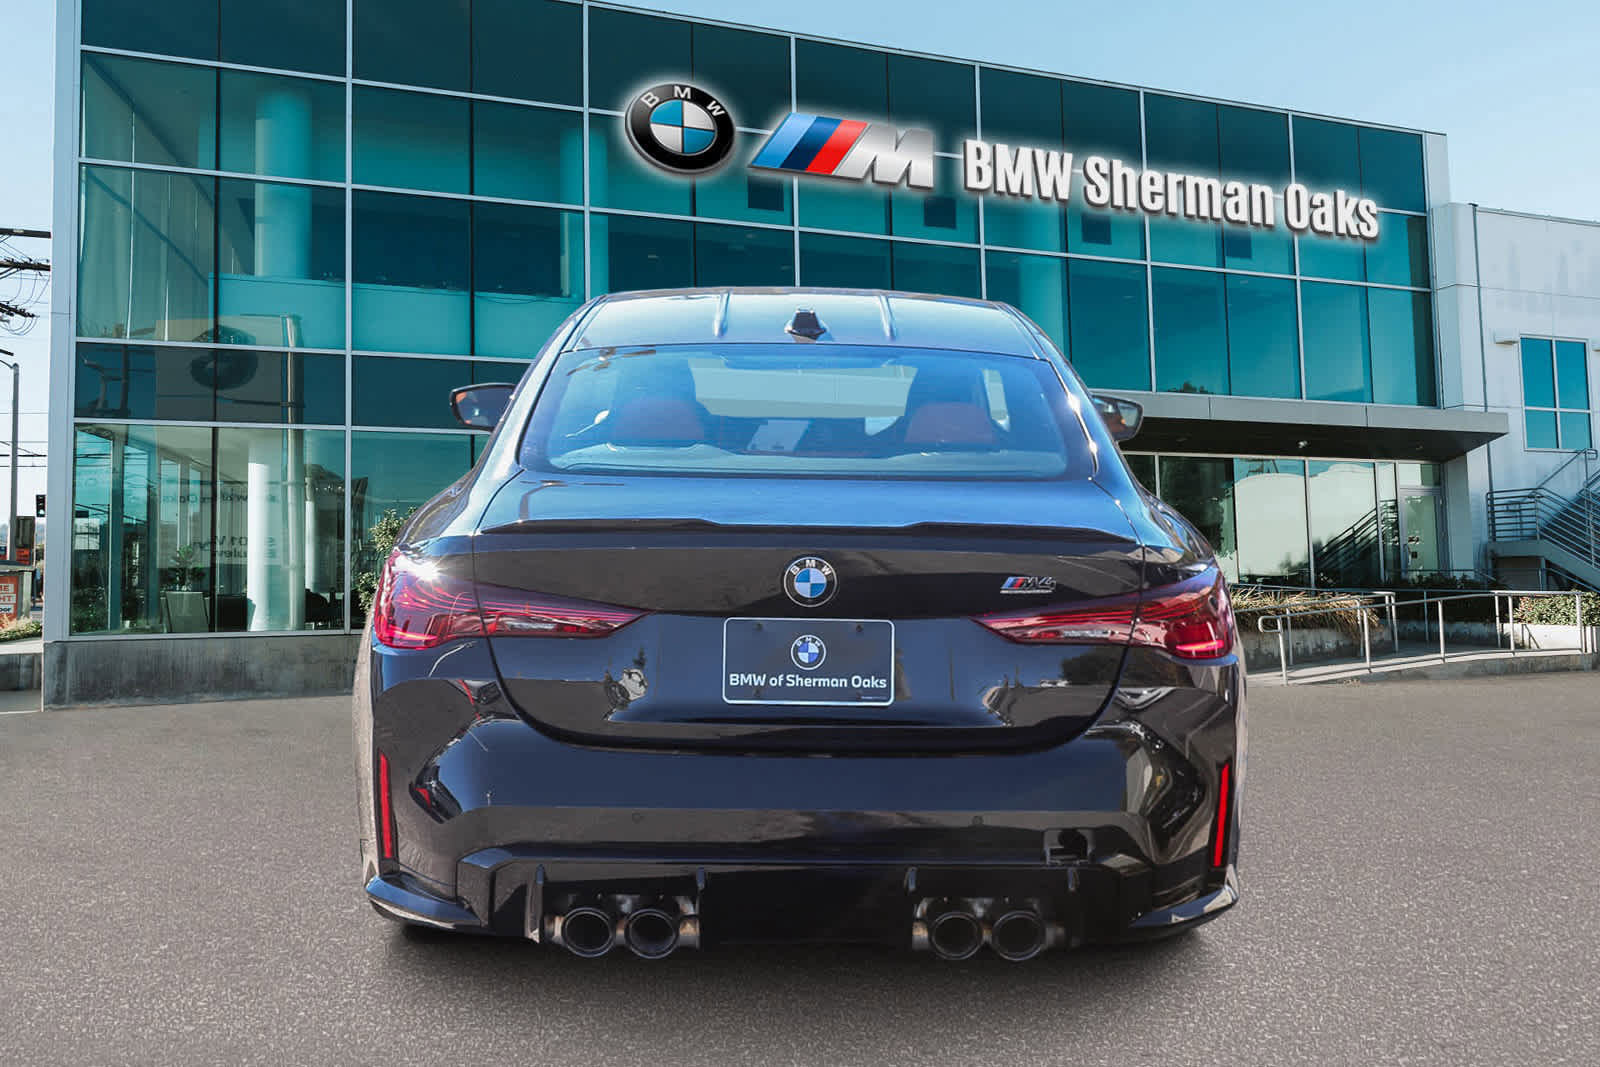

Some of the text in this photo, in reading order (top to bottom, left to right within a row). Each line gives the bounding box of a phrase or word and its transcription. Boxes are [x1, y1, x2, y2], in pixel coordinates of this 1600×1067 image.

[641, 84, 725, 117] BMW
[964, 138, 1380, 241] BMW Sherman Oaks
[790, 559, 832, 575] BMW
[729, 673, 887, 688] BMW of Sherman Oaks
